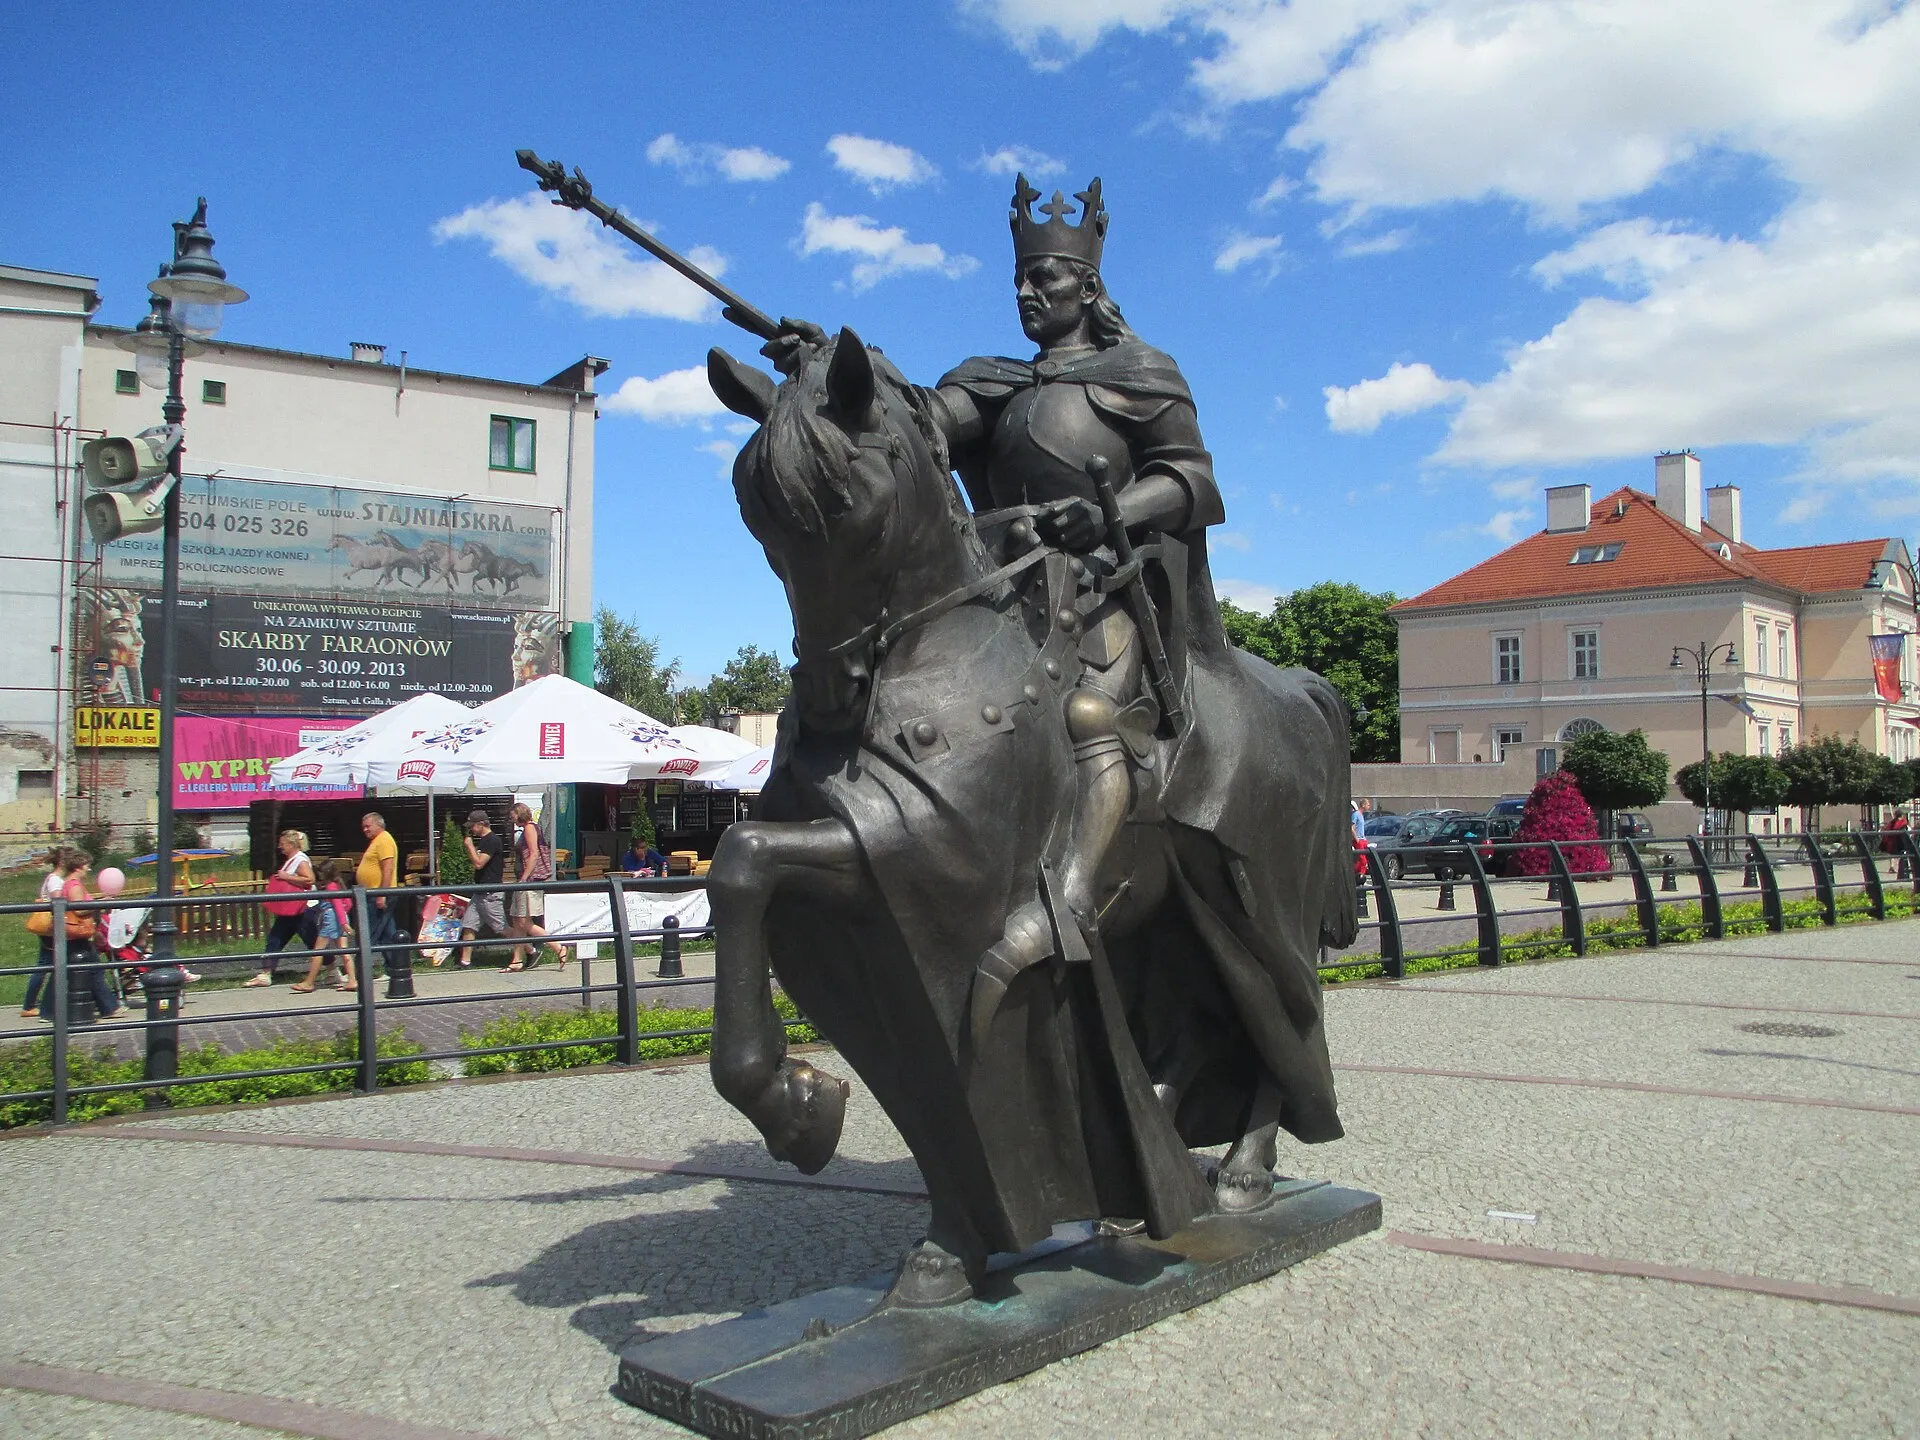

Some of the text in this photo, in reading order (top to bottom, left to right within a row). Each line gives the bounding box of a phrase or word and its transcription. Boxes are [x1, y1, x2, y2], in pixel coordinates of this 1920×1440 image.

[179, 492, 308, 514] SZTUMSKIE POLE
[179, 510, 309, 538] 504 025 326
[147, 542, 159, 551] 24
[229, 547, 263, 559] JAZDY
[265, 549, 310, 562] KONNEJ
[120, 557, 164, 569] IMPREZ
[253, 601, 422, 619] UNIKATOWA WYSTAWA O EGIPCIE
[264, 615, 417, 633] NA ZAMKU W SZTUMIE
[218, 630, 312, 652] SKARBY
[256, 657, 302, 673] 30.06
[317, 660, 366, 675] 30.09.
[368, 661, 406, 677] 2013
[216, 676, 229, 686] od
[231, 677, 290, 687] 12.00-20.00
[300, 680, 320, 689] sob.
[321, 680, 334, 689] od
[336, 680, 391, 690] 12.00-16.00
[400, 682, 427, 692] niedz.
[428, 683, 441, 692] od
[442, 683, 493, 693] 12.00-20.00
[322, 695, 350, 706] Sztum,
[363, 696, 384, 706] Galla
[79, 711, 155, 730] LOKALE
